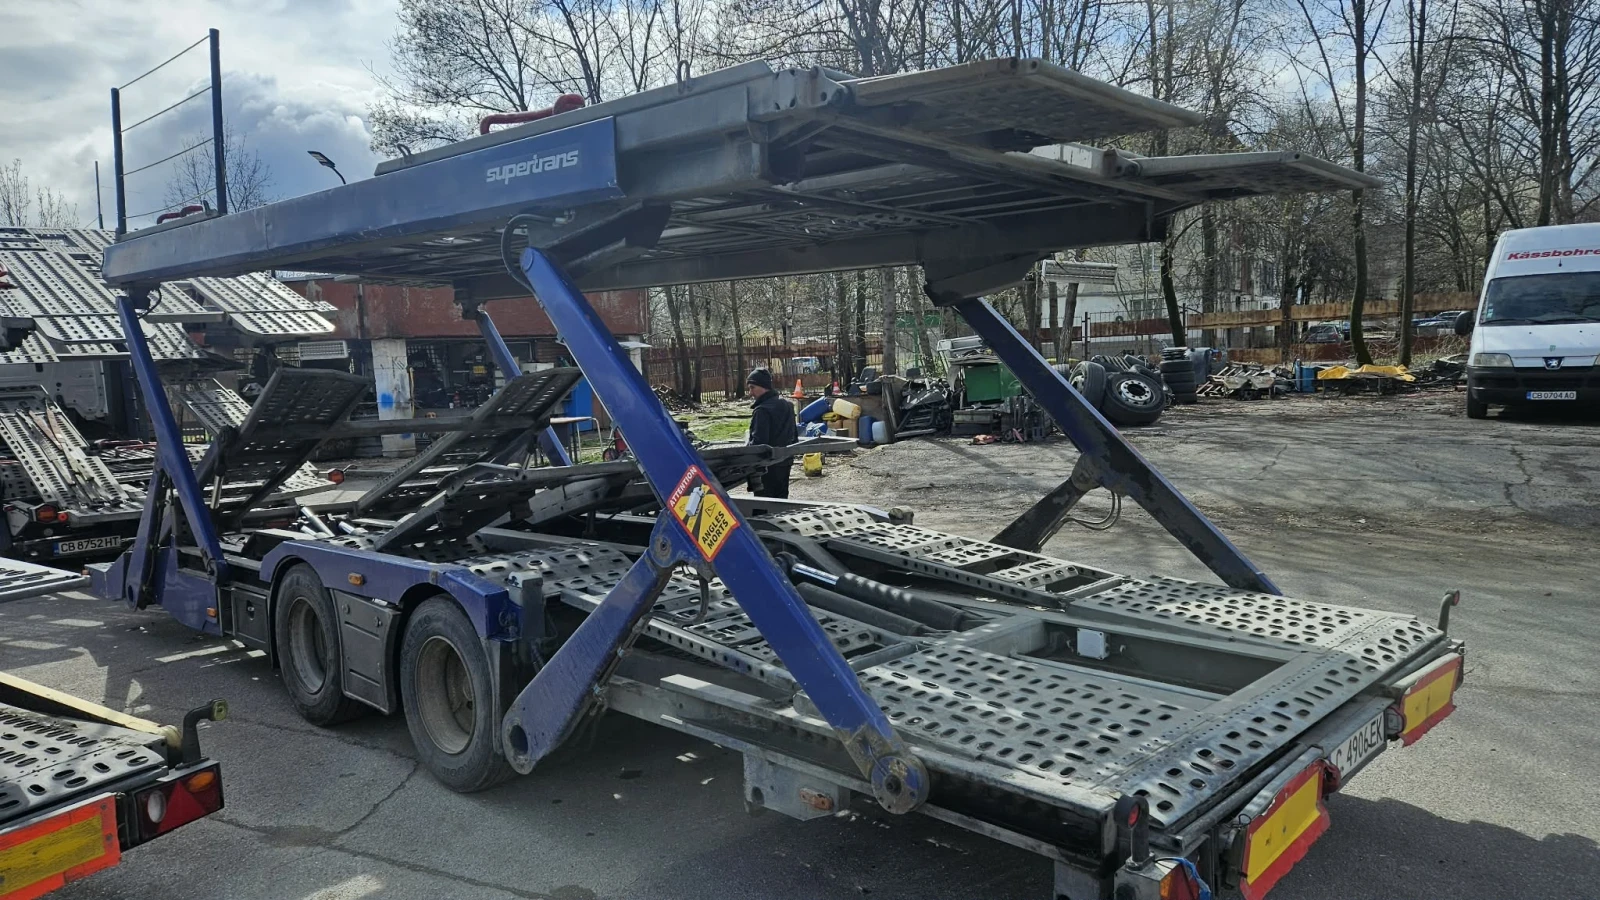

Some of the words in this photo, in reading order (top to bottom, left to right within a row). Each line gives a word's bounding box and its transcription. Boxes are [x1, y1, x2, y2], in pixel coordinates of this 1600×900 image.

[486, 150, 579, 185] supertrans
[669, 466, 697, 507] ATTENTION
[701, 510, 725, 544] ANGLES
[706, 519, 729, 550] MORTS
[61, 542, 75, 552] CB
[77, 539, 104, 550] 8752
[105, 537, 119, 547] HT
[1346, 725, 1369, 767] 4906
[1369, 716, 1383, 748] EK
